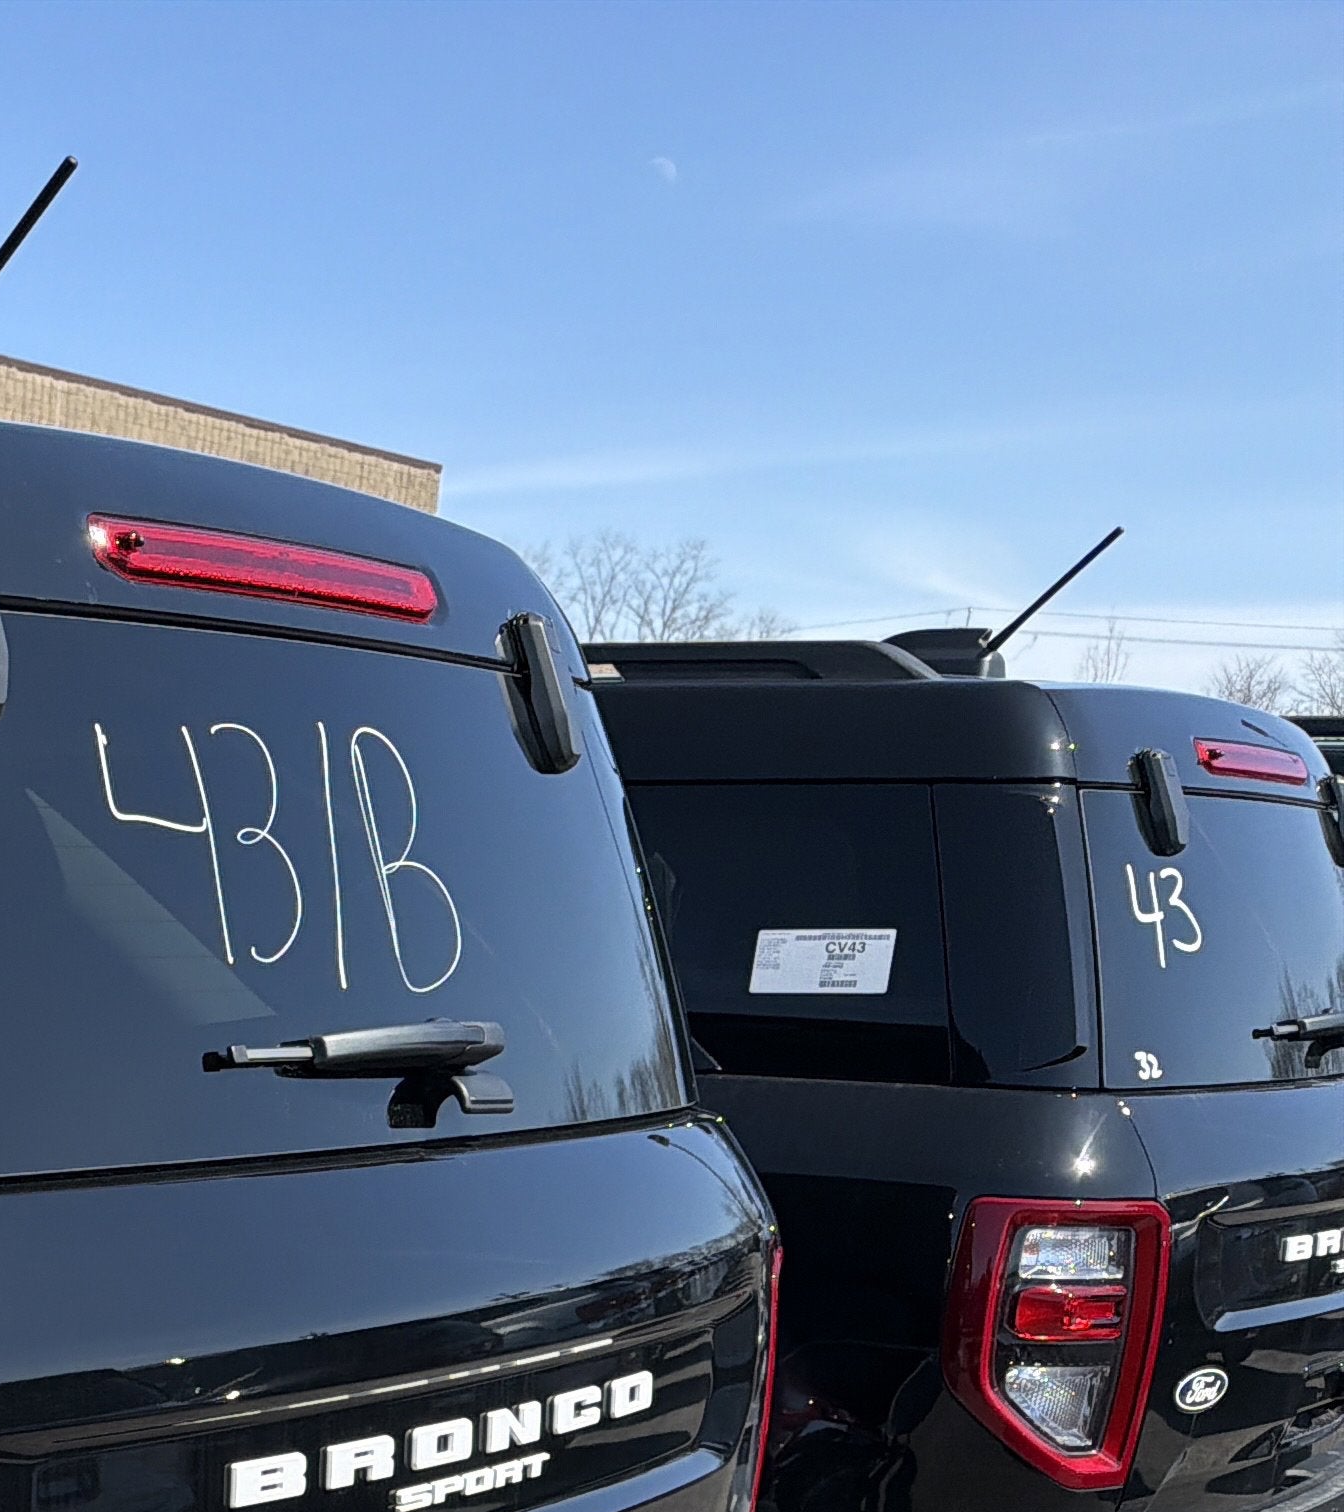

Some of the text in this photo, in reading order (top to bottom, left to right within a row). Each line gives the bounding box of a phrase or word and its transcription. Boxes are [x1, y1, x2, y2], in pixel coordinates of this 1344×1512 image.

[1125, 863, 1203, 969] 43
[825, 941, 867, 954] CV43
[1280, 1229, 1344, 1262] BR
[225, 1370, 654, 1509] BRONCO
[391, 1451, 551, 1512] SPORT
